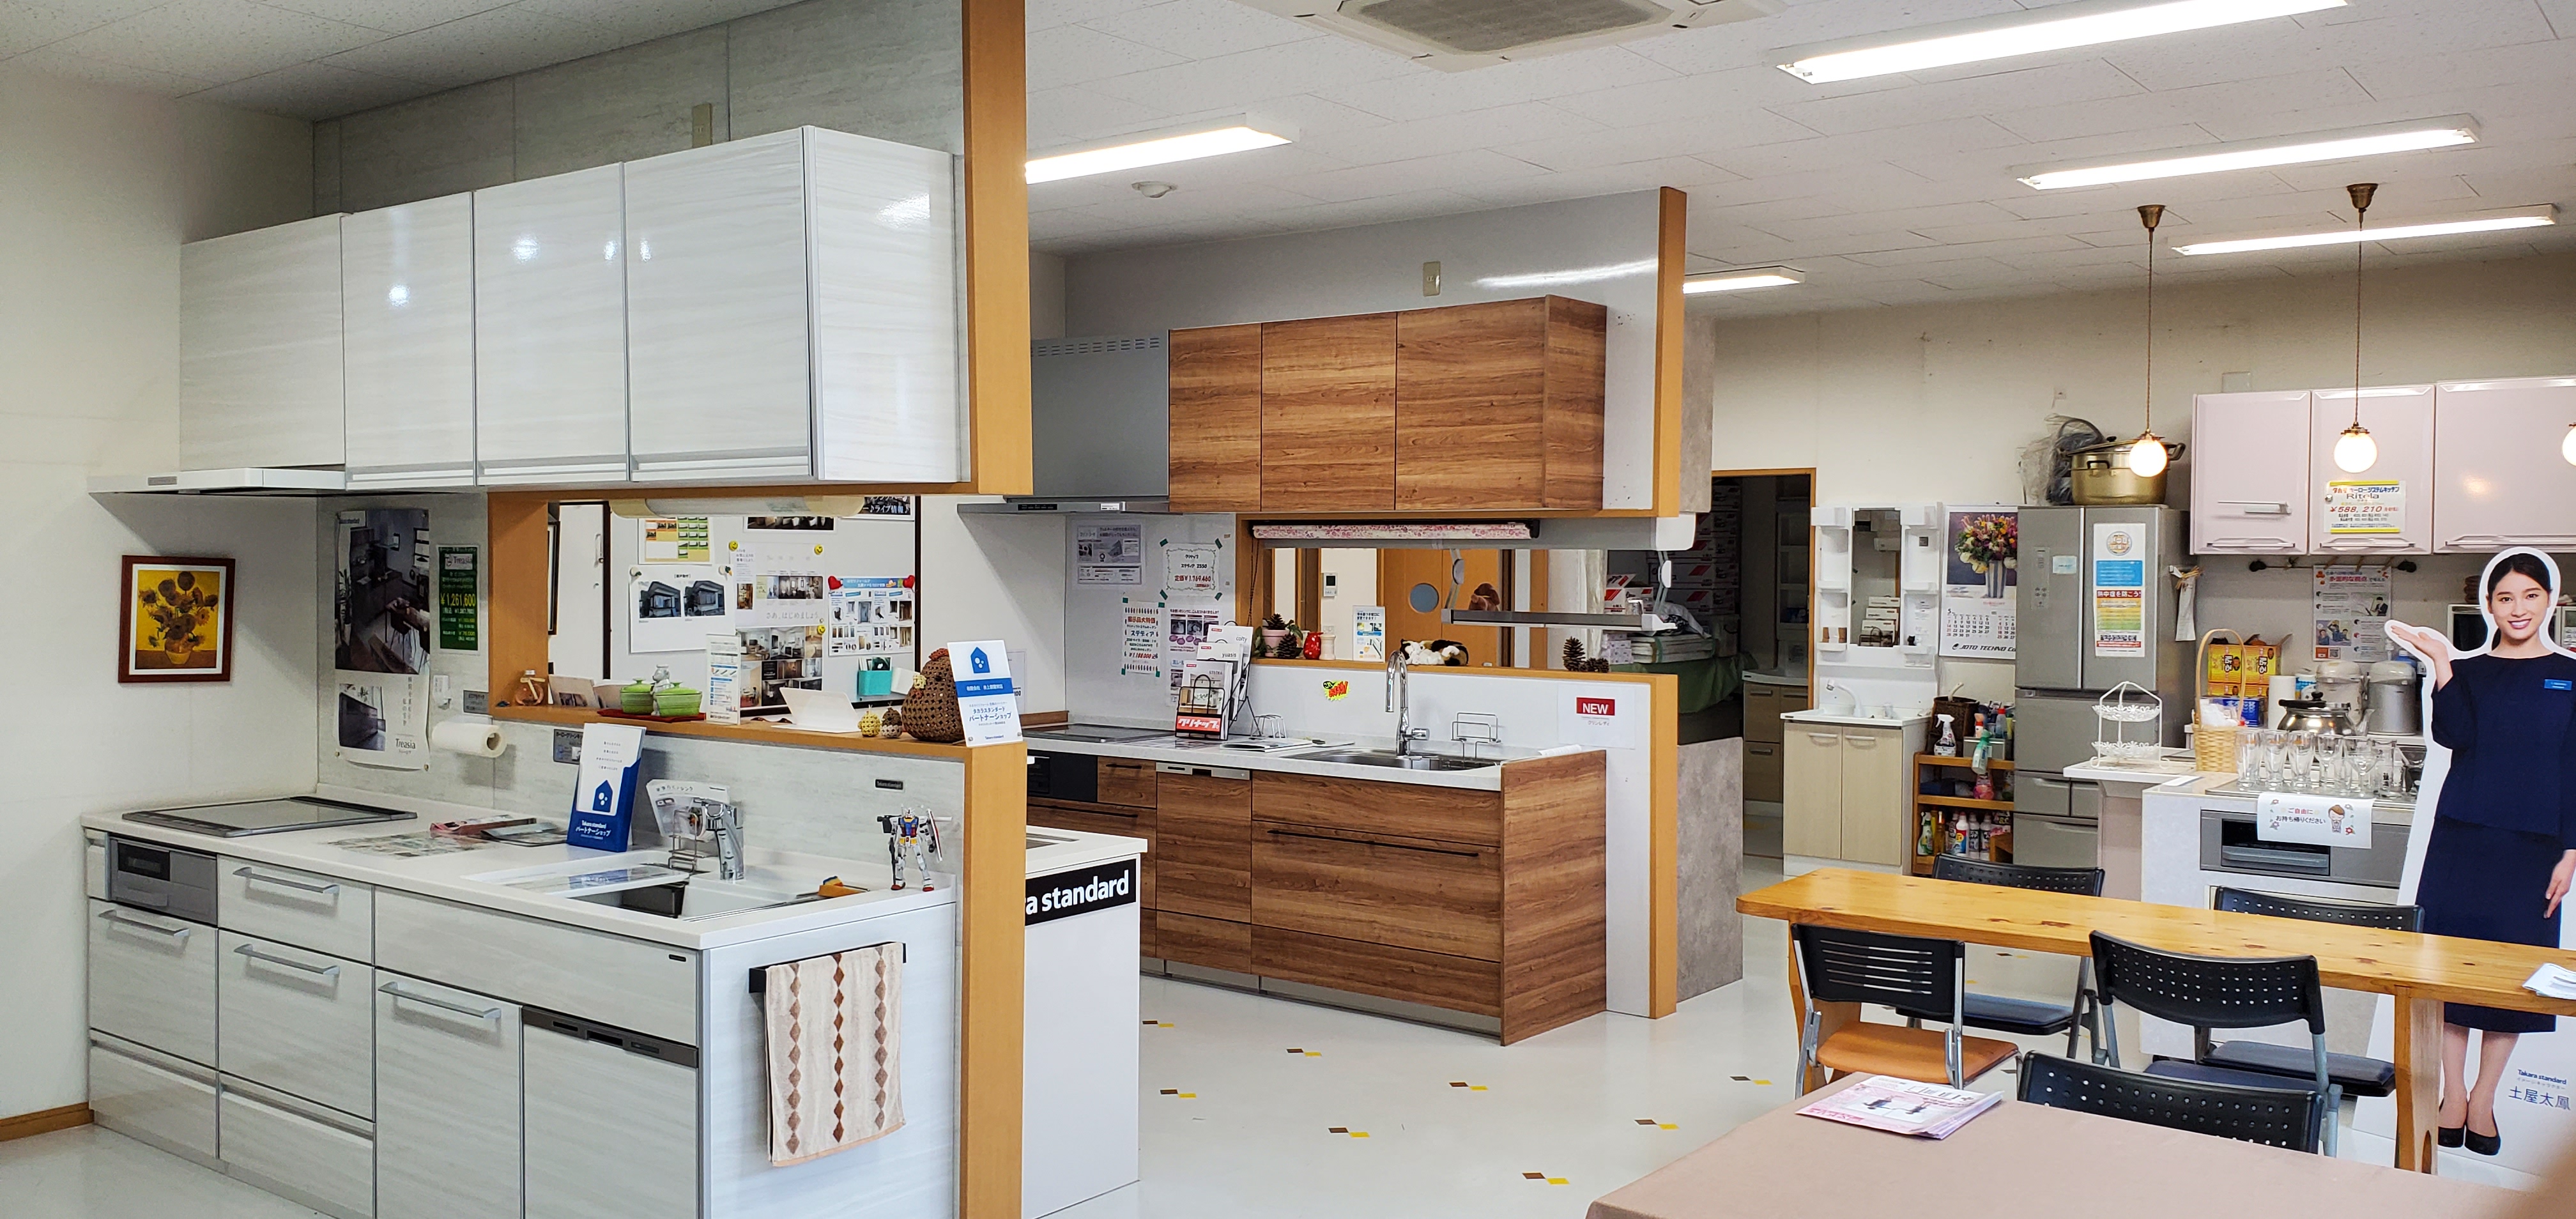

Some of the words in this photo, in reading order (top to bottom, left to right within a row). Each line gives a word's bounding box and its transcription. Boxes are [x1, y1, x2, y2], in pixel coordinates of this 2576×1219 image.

[1583, 703, 1609, 714] NEW
[969, 712, 1011, 721] パートナーショップ
[1178, 718, 1217, 728] クリナップ
[395, 739, 415, 749] Treasia
[2276, 816, 2326, 824] お持ち帰りください
[576, 826, 611, 836] パートナーショップ
[1041, 870, 1129, 912] standard
[2518, 1069, 2537, 1078] Takara
[2538, 1075, 2566, 1084] standard
[2508, 1085, 2571, 1110] 土屋太鳳
